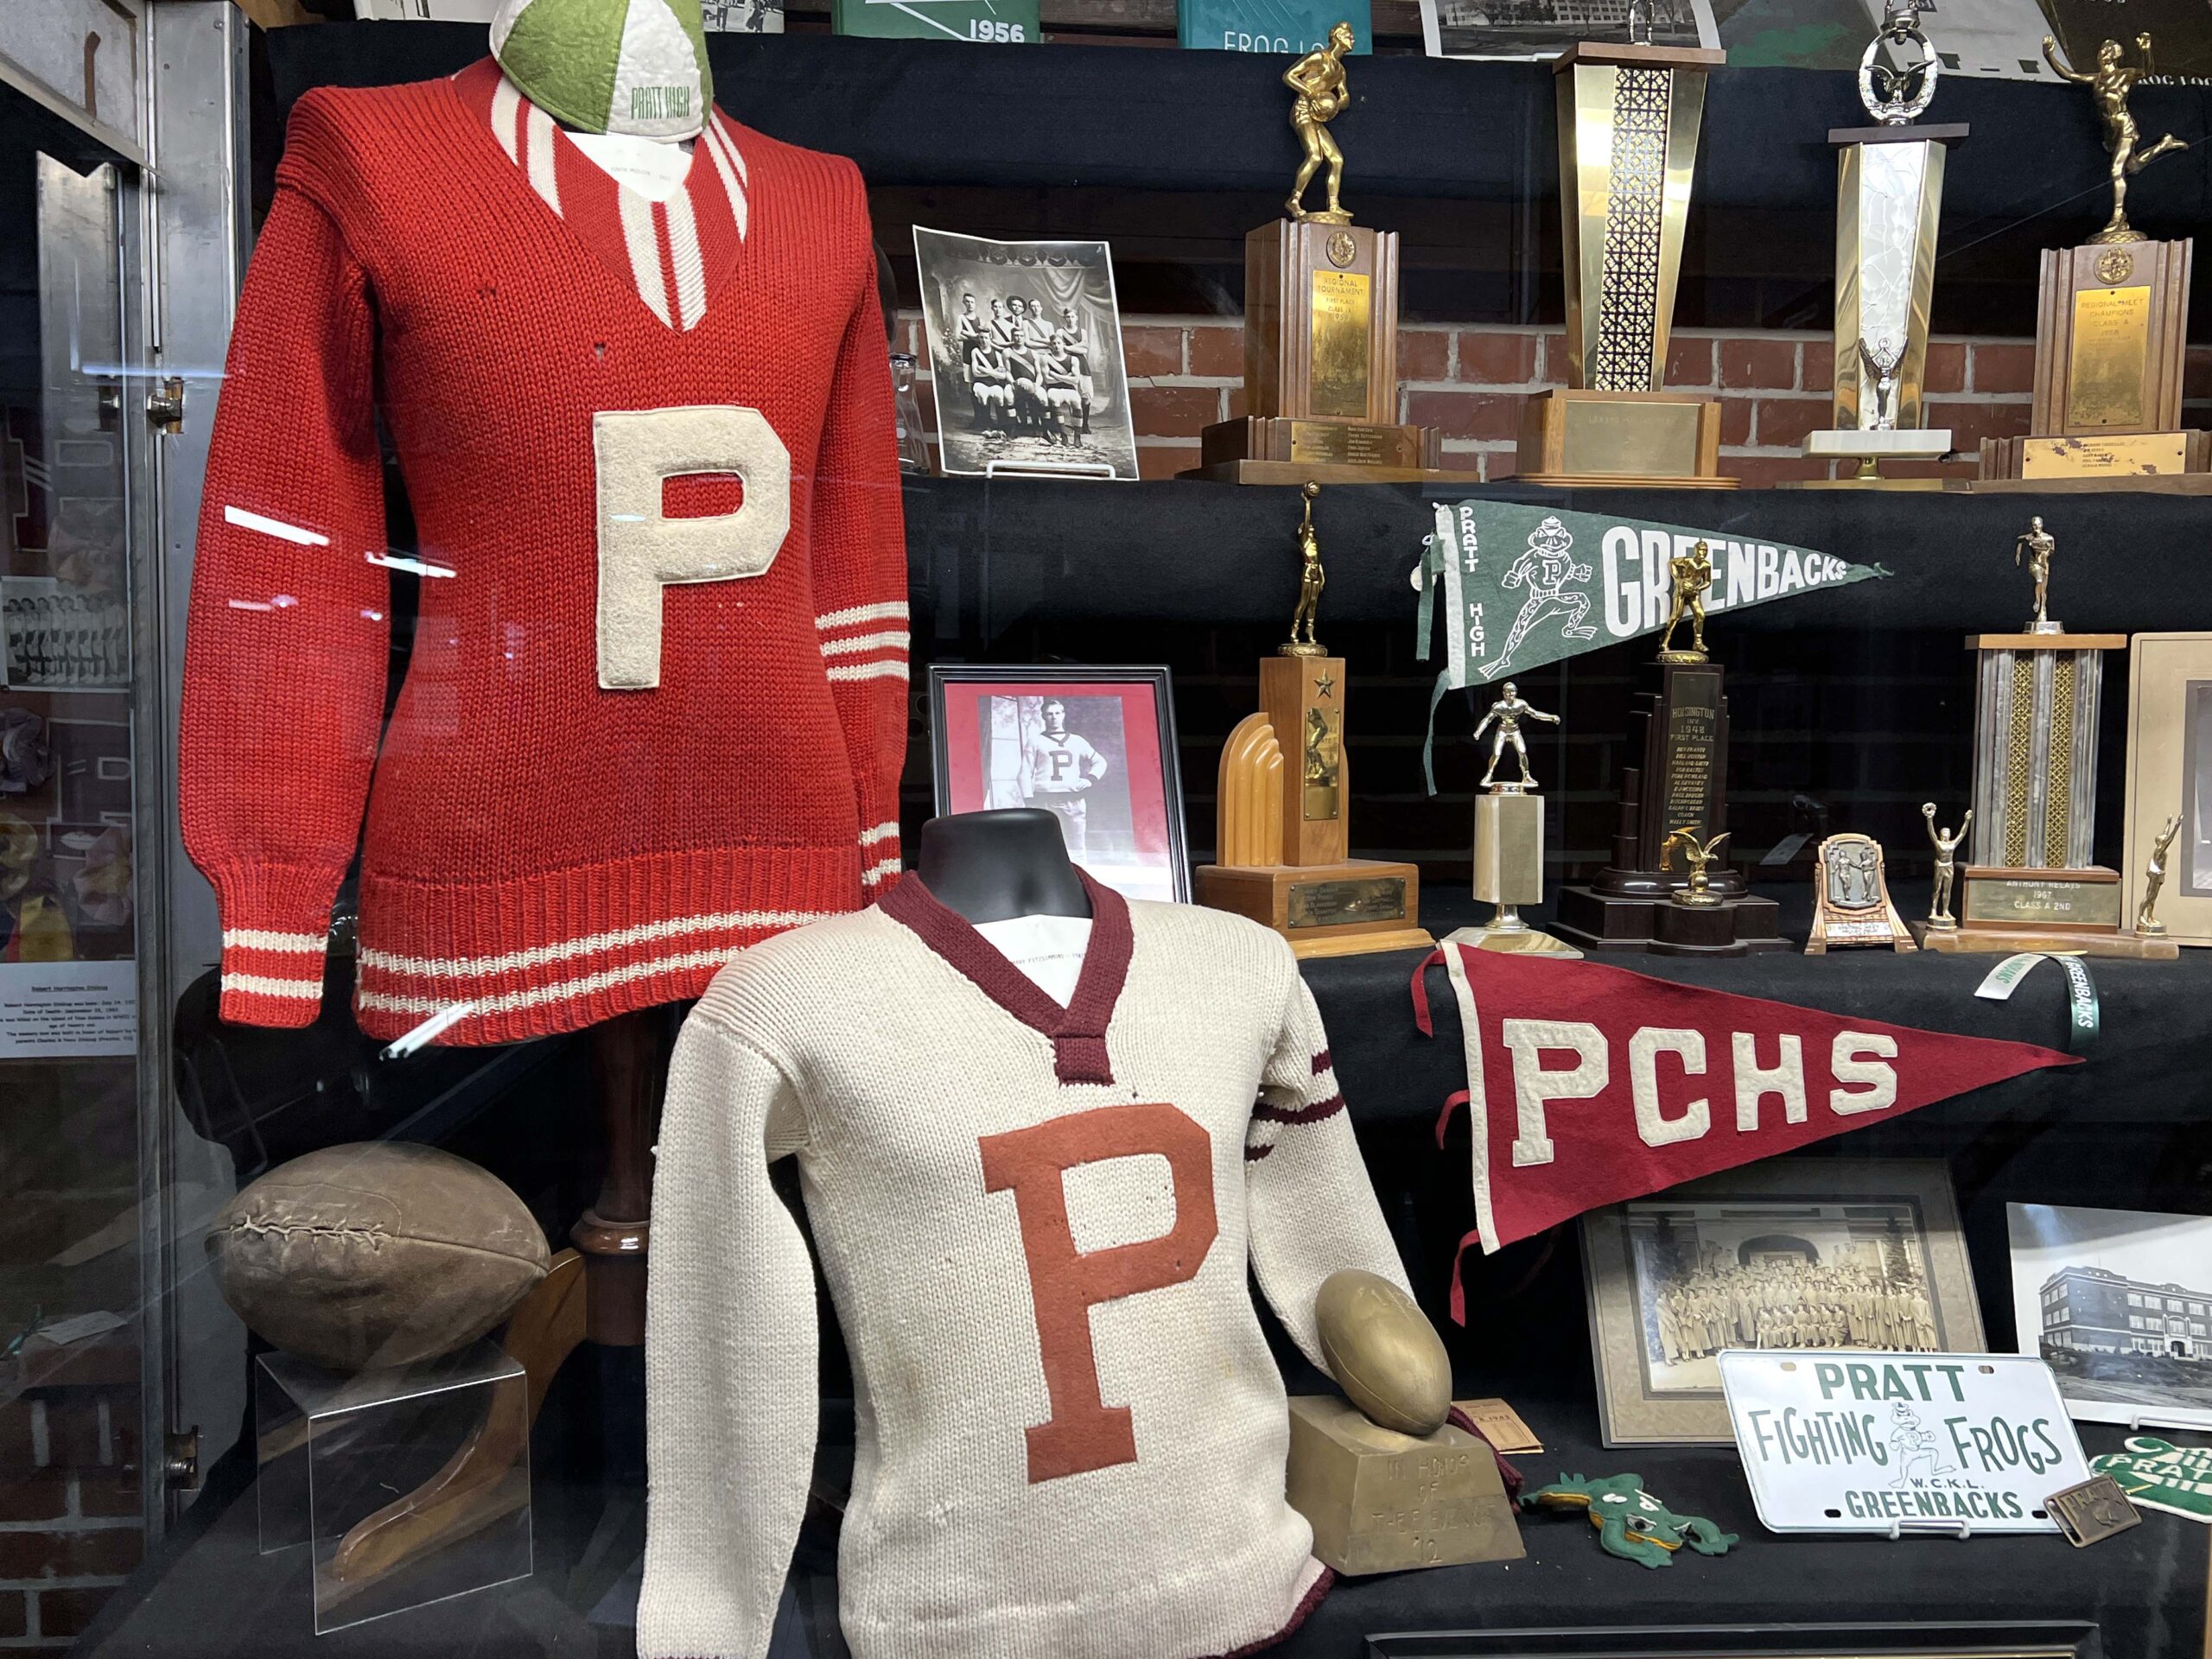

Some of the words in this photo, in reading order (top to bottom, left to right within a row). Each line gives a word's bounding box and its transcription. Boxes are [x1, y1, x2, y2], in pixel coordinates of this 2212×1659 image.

[970, 19, 1025, 42] 1956
[631, 86, 662, 119] PRATT
[664, 86, 690, 118] HIGH
[1318, 285, 1363, 296] TOURNAMENT
[2089, 308, 2134, 317] CHAMPIONS
[592, 405, 791, 691] P
[1459, 506, 1479, 573] PRATT
[1470, 603, 1485, 658] HIGH
[1542, 560, 1561, 585] P
[1049, 750, 1072, 781] P
[2013, 900, 2041, 910] CLASS
[2053, 902, 2071, 911] 2ND
[2033, 891, 2052, 899] 1967
[2065, 961, 2094, 1028] GREENBACKS
[1503, 1017, 1898, 1166] PCHS
[979, 1103, 1219, 1484] P
[1815, 1363, 1964, 1402] PRATT
[1748, 1406, 1889, 1467] FIGHTING
[1944, 1416, 2063, 1475] FROGS
[1846, 1490, 2024, 1520] GREENBACKS
